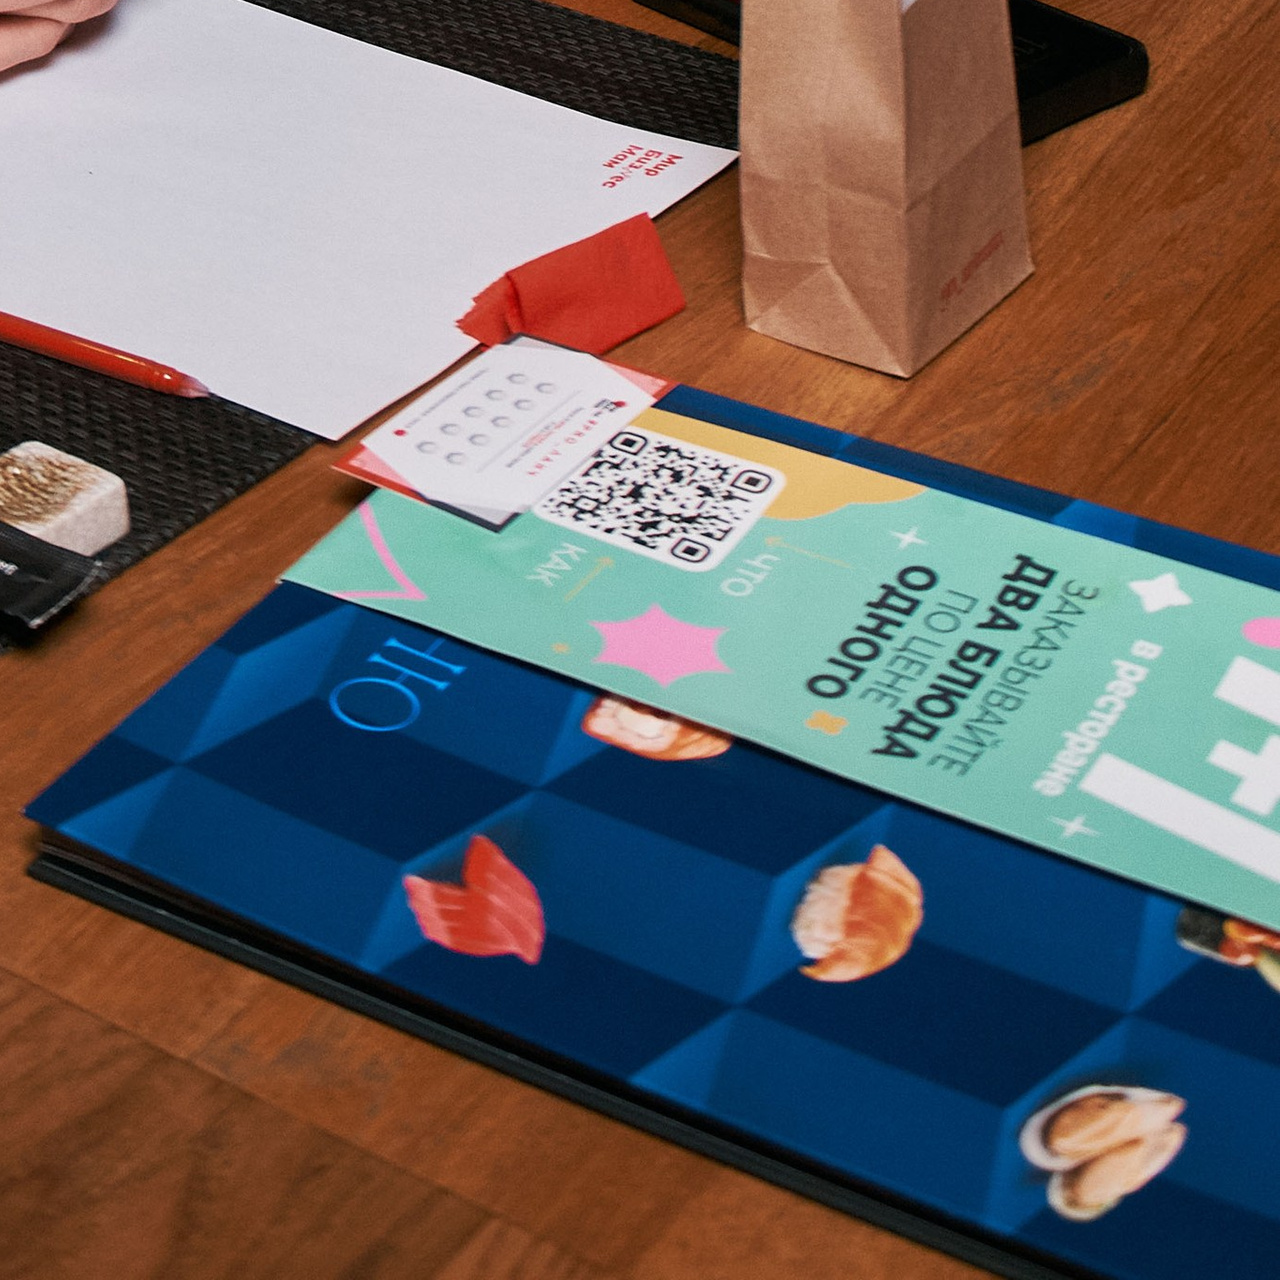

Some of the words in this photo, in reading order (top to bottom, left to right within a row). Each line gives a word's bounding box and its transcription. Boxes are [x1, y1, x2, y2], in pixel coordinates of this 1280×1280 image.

[602, 144, 644, 169] Мам
[644, 153, 684, 177] Мир
[524, 541, 588, 588] КАК
[720, 552, 782, 598] ЧТО
[975, 552, 1059, 631] ДВА
[805, 564, 940, 700] ОДНОГО
[923, 589, 980, 634] ПО
[858, 635, 947, 710] ЦЕНЕ
[870, 639, 1003, 760] БЛЮДА
[926, 578, 1100, 777] ЗАКАЗЫВАЙТЕ
[1032, 658, 1149, 798] ресторане
